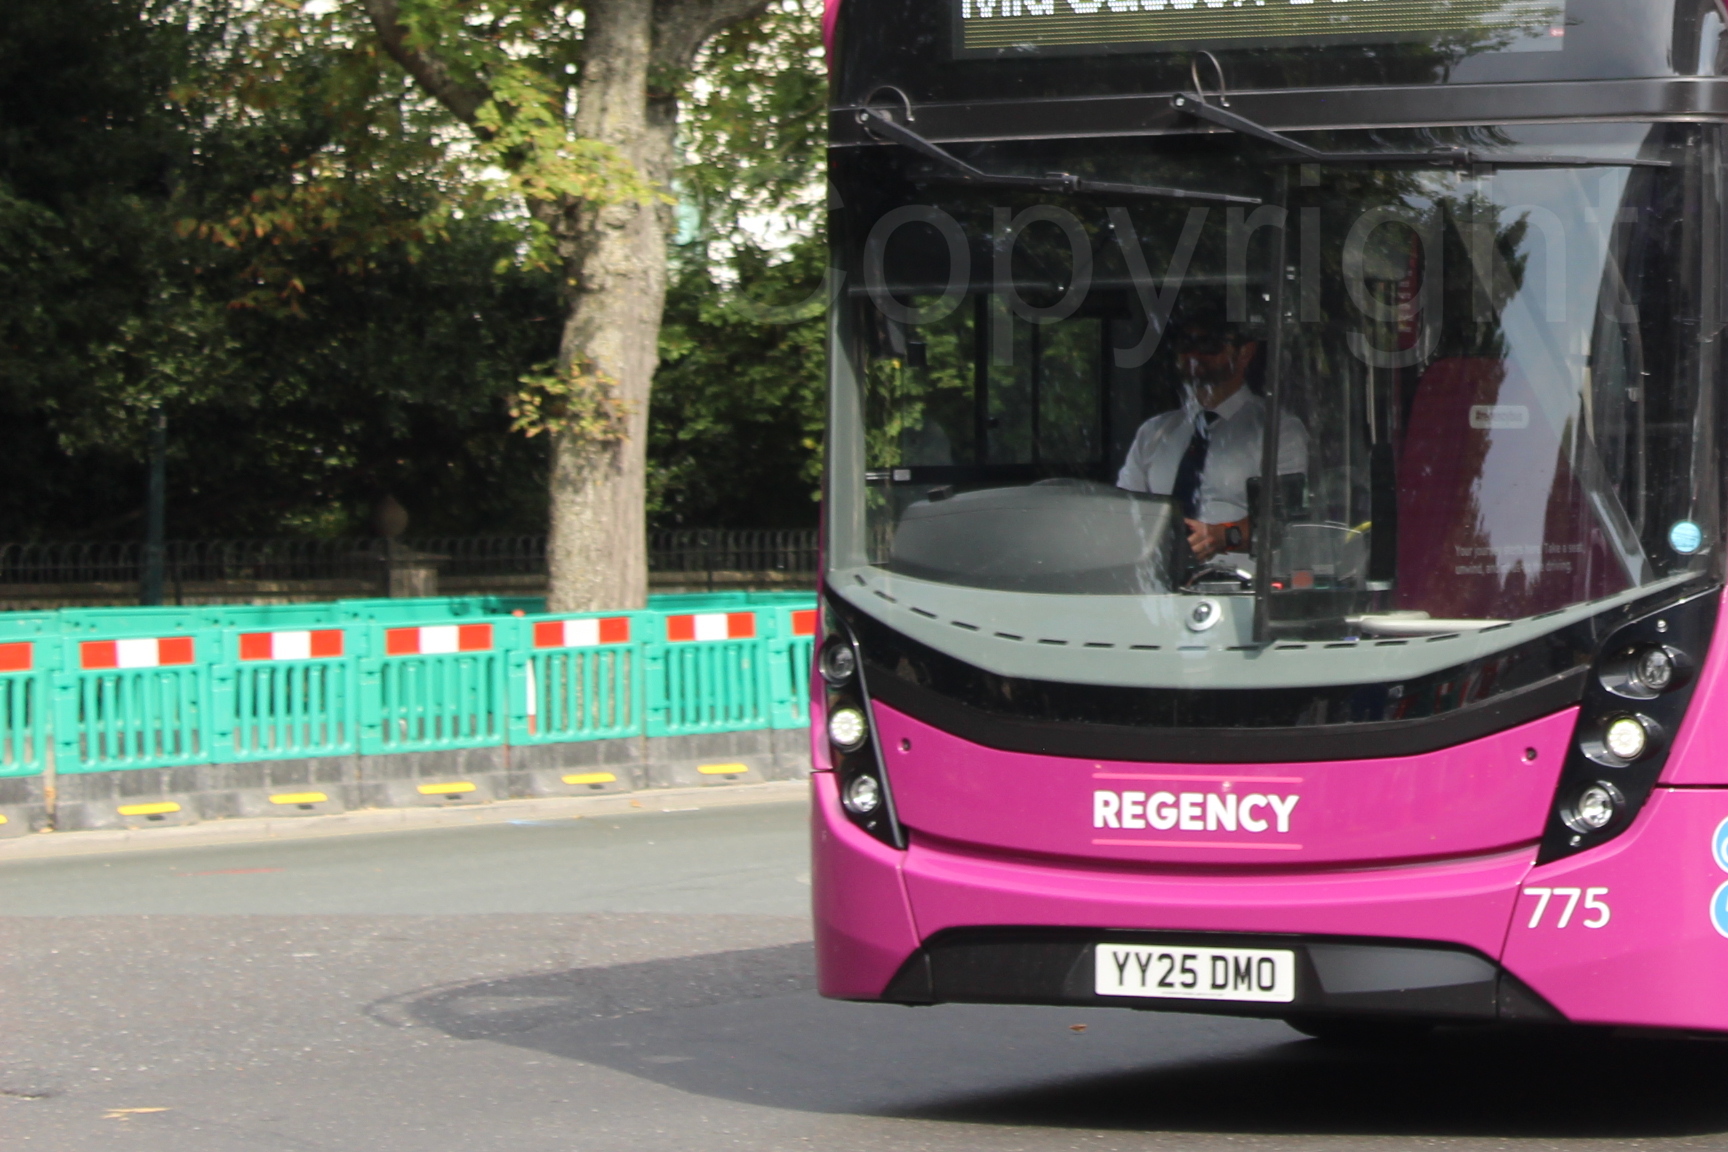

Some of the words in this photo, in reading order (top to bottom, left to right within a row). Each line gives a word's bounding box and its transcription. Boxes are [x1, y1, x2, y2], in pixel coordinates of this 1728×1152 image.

[1093, 790, 1300, 833] REGENCY
[1523, 887, 1611, 929] 775
[1112, 951, 1198, 989] YY25
[1210, 955, 1275, 992] DMO
